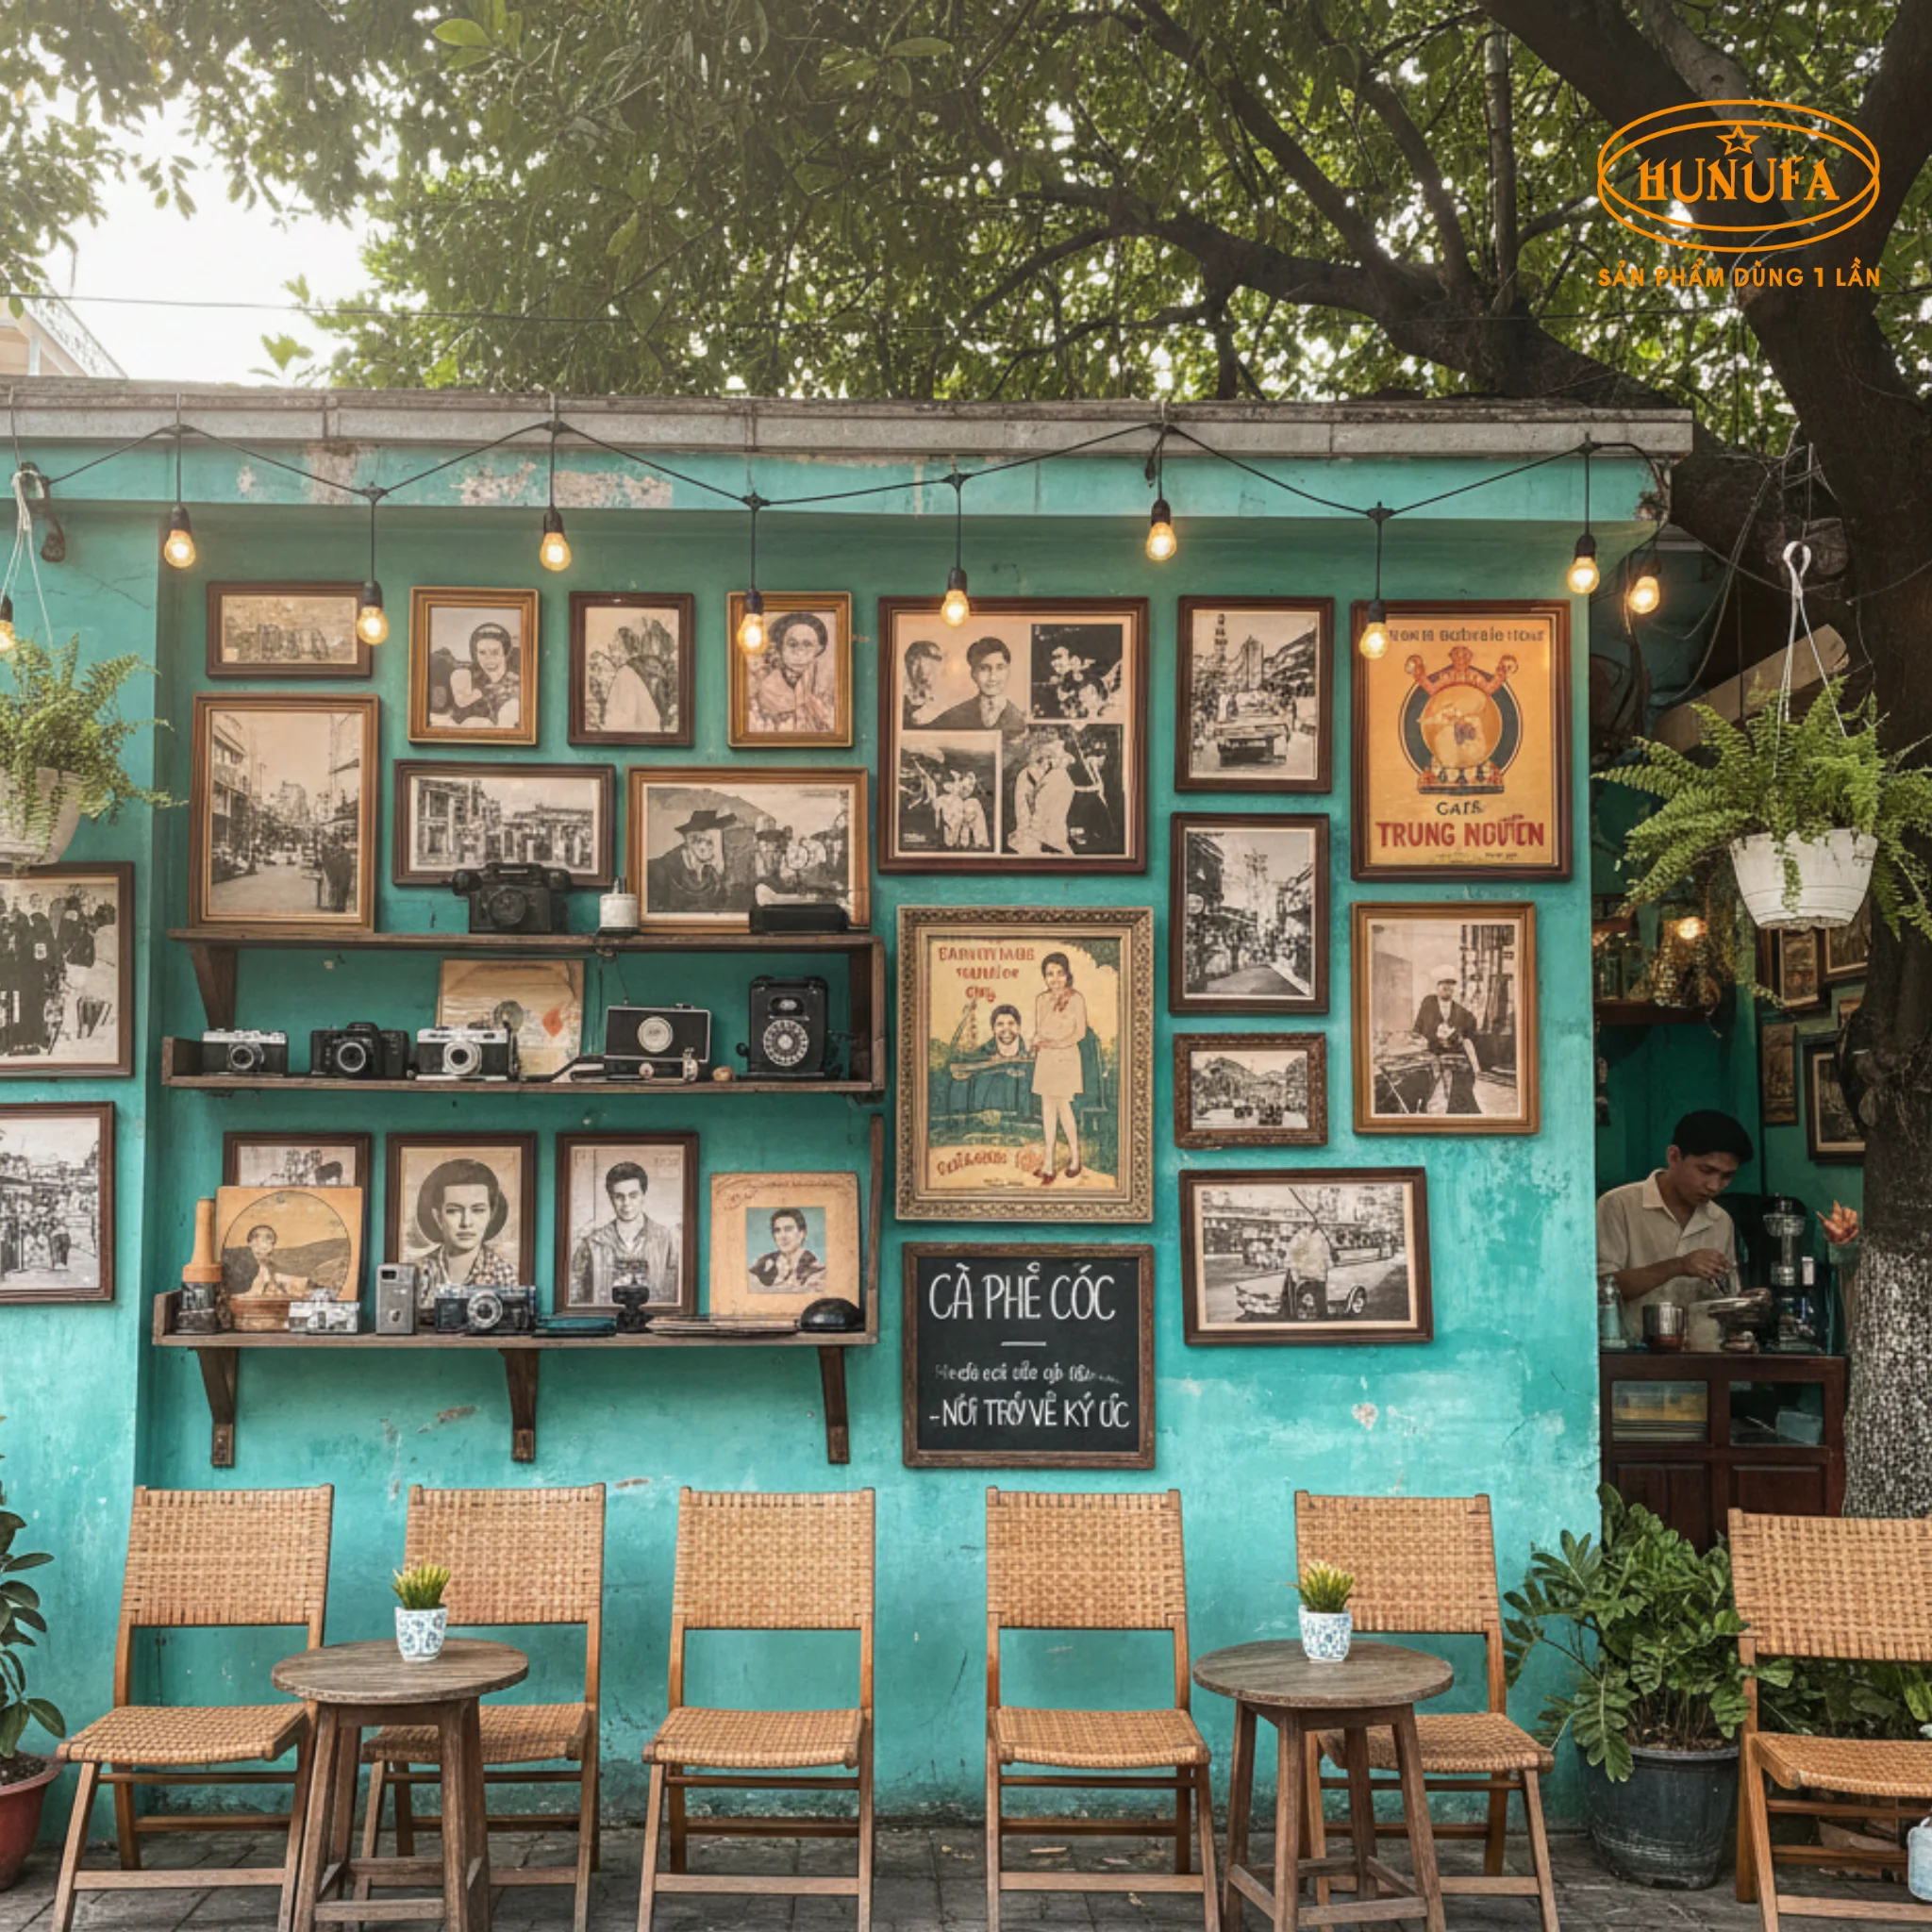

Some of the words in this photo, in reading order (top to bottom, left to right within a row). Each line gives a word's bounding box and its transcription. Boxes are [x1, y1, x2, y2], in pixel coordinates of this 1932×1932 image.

[1375, 822, 1455, 847] TRUNG
[928, 1262, 974, 1320] CÀ
[1050, 1264, 1116, 1321] CÓC
[1064, 1391, 1095, 1427] KÝ
